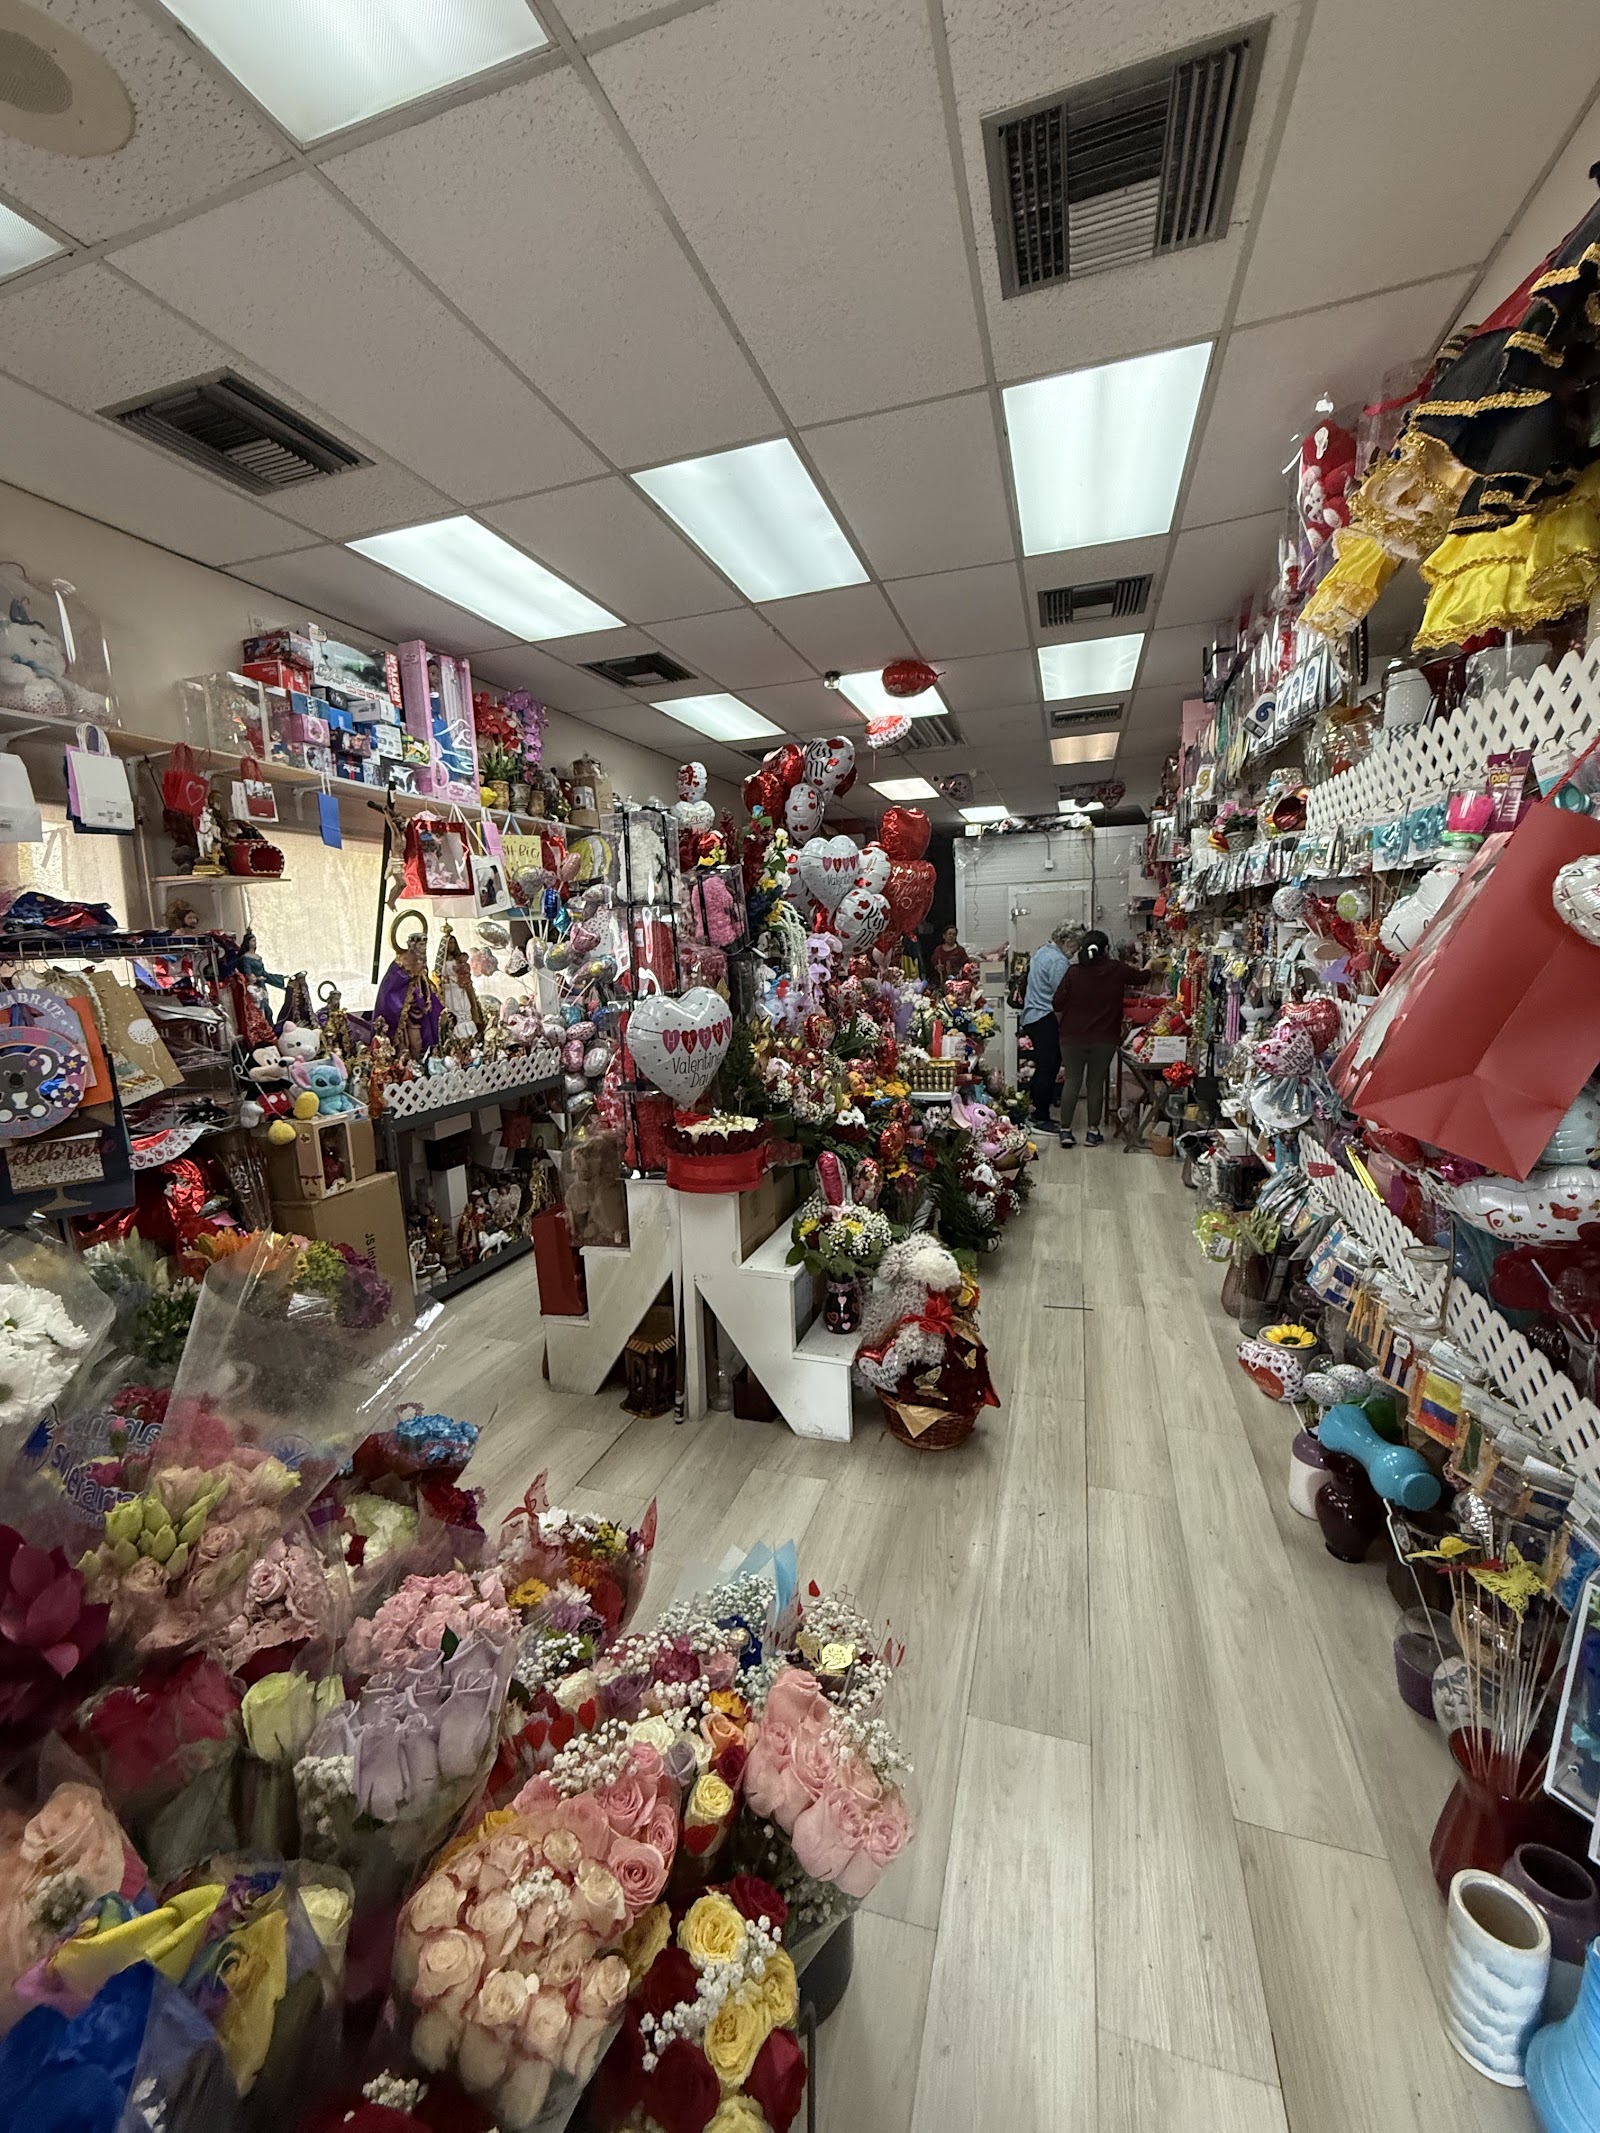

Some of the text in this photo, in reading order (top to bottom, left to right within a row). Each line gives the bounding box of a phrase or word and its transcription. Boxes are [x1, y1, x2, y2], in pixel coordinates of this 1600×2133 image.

[806, 740, 833, 761] Kiss
[1475, 1208, 1504, 1231] Te
[365, 1233, 375, 1246] JS
